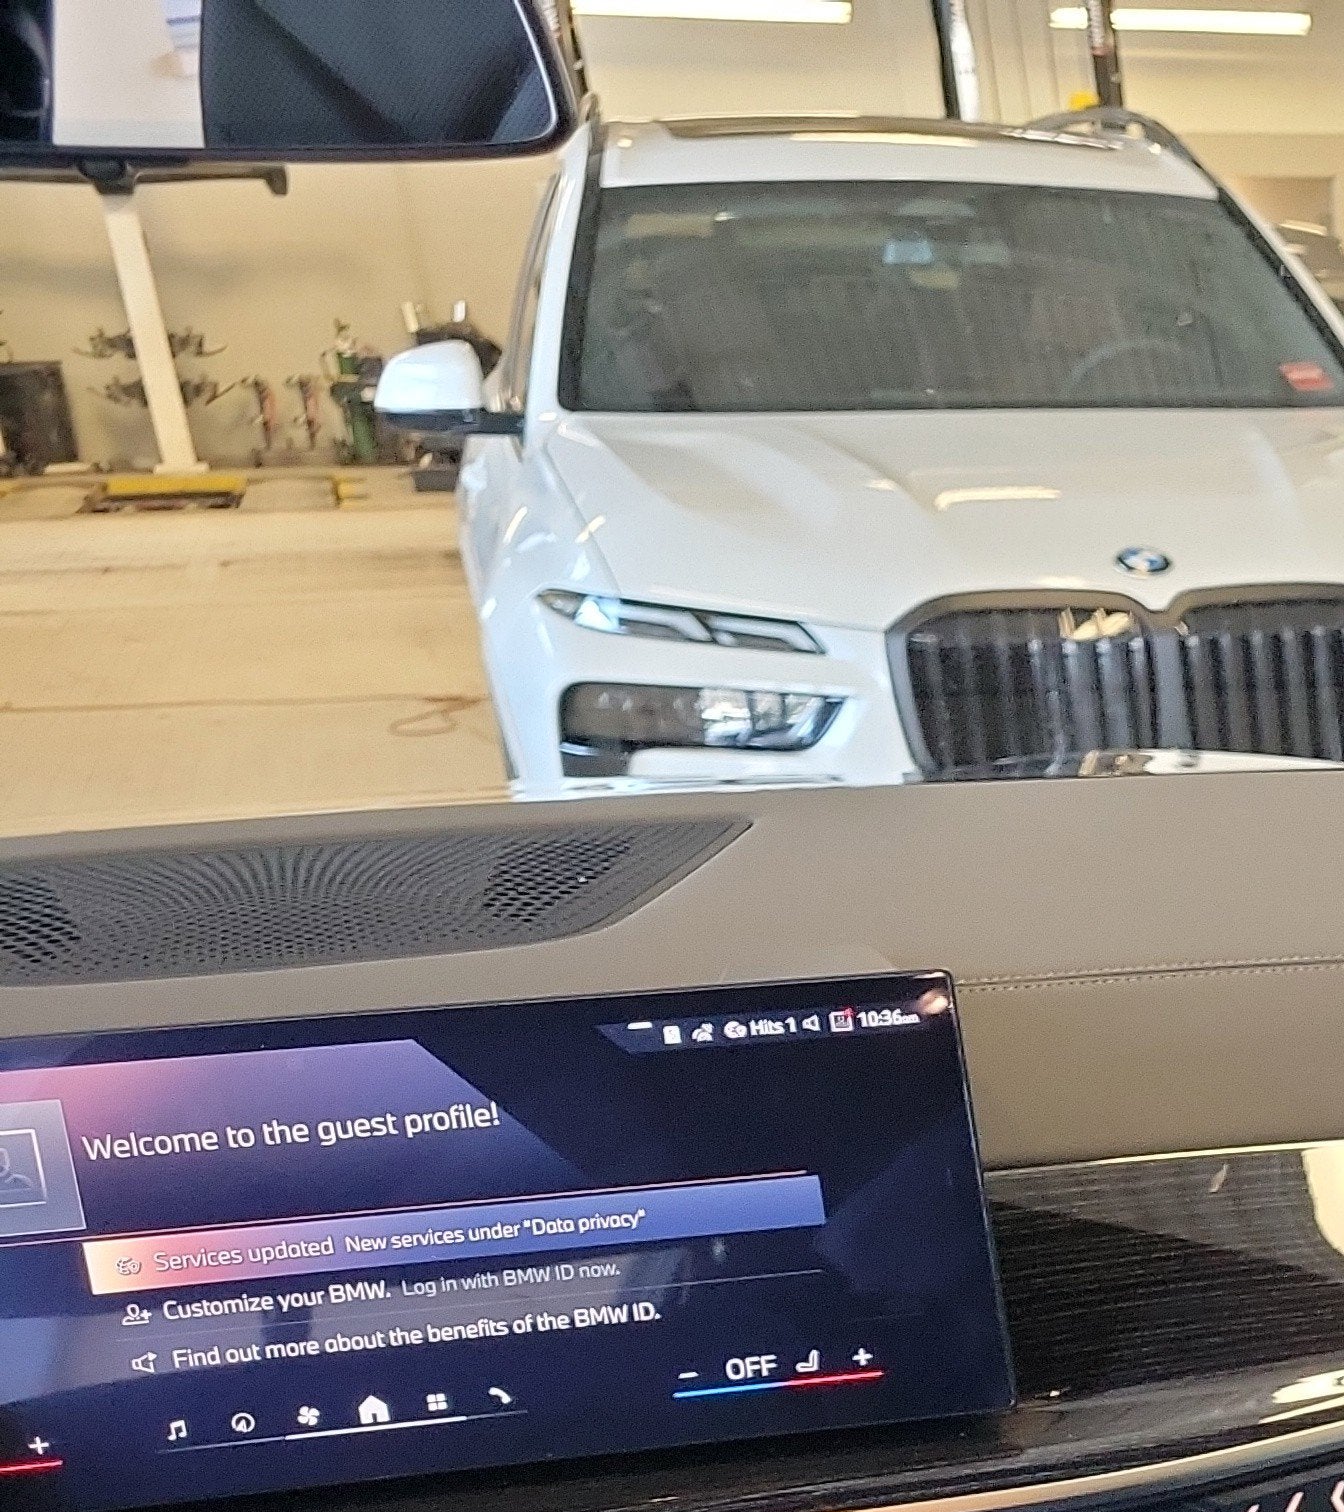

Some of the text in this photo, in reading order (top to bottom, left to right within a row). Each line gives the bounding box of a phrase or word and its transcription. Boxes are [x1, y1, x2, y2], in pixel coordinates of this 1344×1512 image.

[749, 1017, 797, 1035] Hits 1
[82, 1101, 500, 1160] Welcome to the guest profile!
[153, 1248, 242, 1271] Services
[248, 1236, 335, 1264] updated
[345, 1236, 387, 1254] New
[391, 1228, 464, 1249] services
[468, 1222, 520, 1241] under
[163, 1263, 621, 1320] Customize your BMW. Log in with BMW ID now.
[172, 1302, 662, 1368] Find out more about the benefits of the BMW ID.
[725, 1354, 778, 1380] OFF
